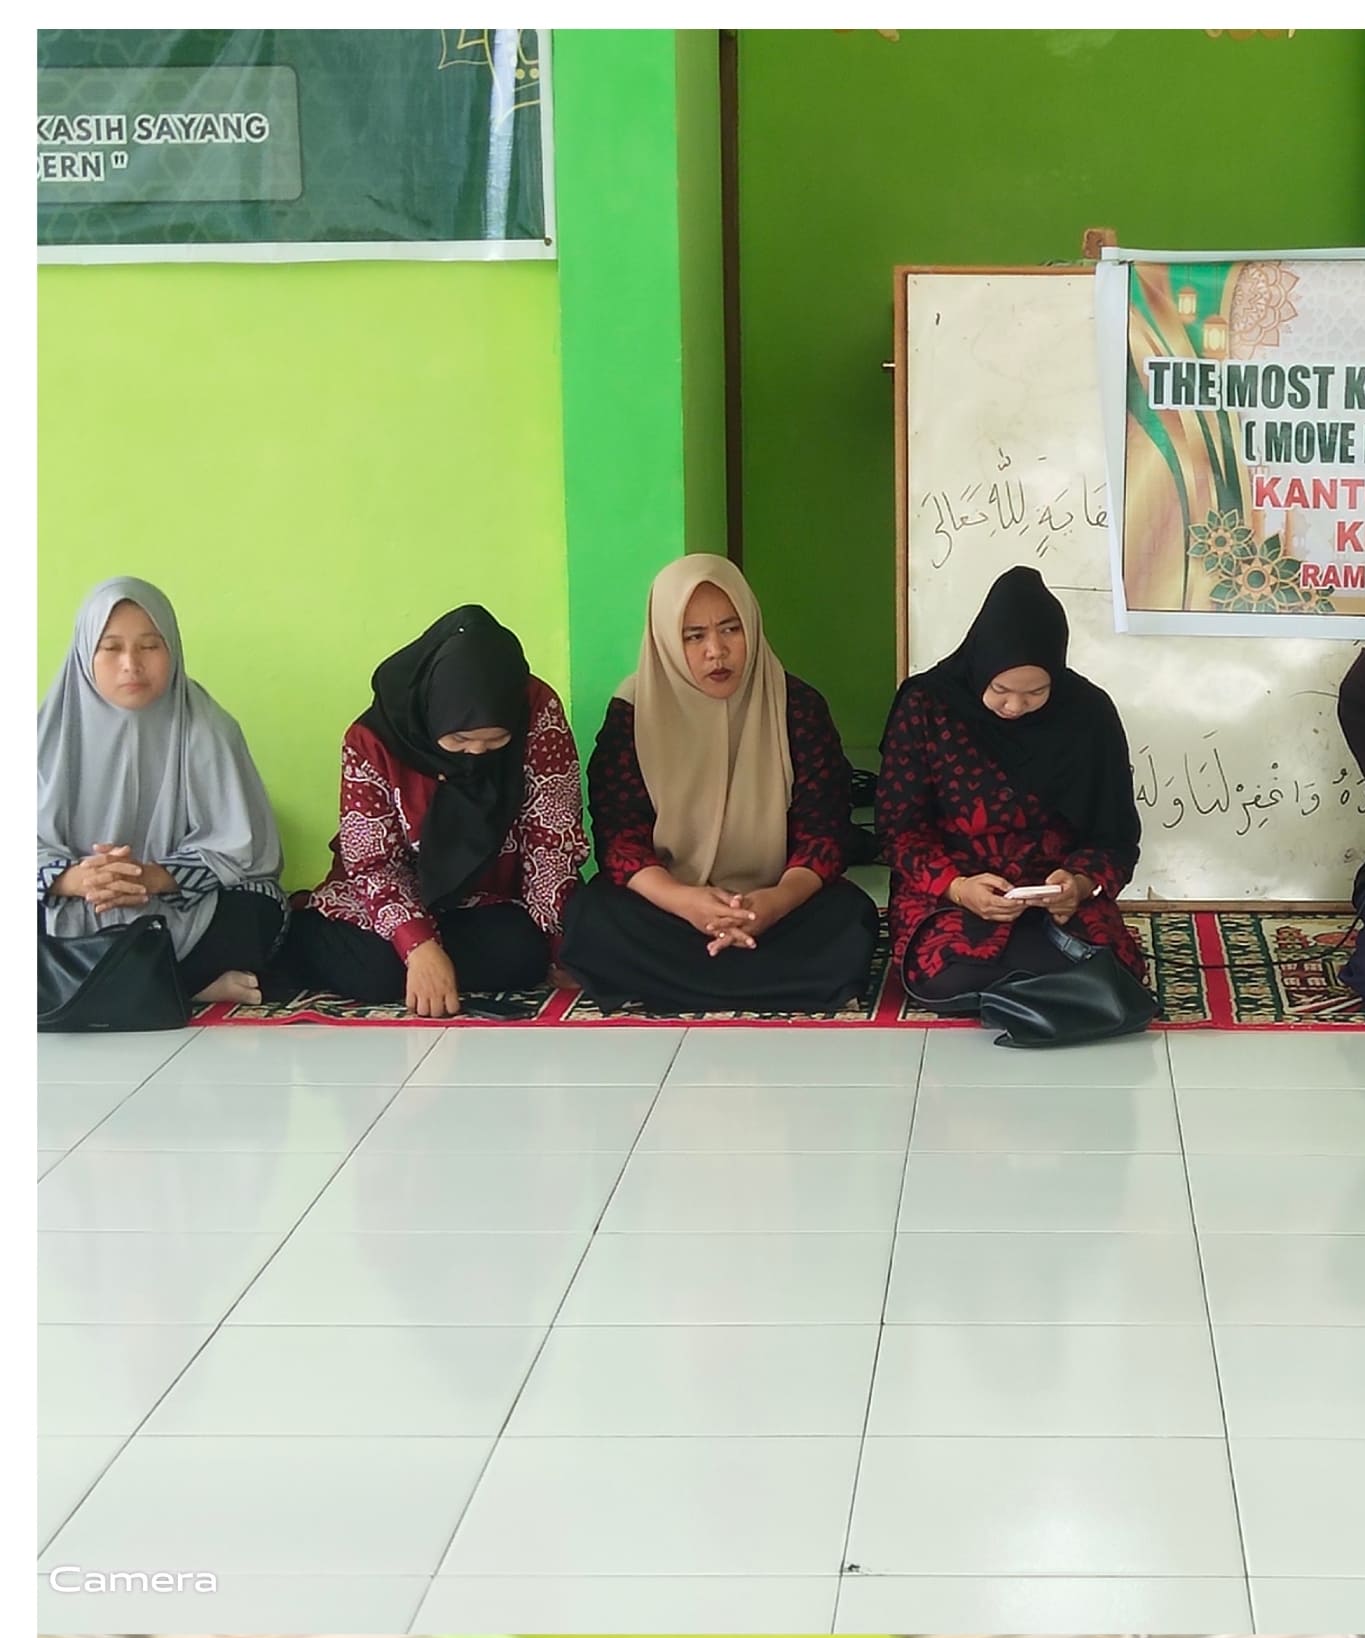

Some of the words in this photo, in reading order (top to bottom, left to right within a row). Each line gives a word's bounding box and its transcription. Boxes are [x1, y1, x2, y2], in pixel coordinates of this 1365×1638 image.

[37, 117, 124, 141] KASIH
[136, 115, 268, 141] SAYANG
[38, 154, 101, 178] ERN
[1148, 361, 1217, 407] THE
[1227, 364, 1336, 410] MOST
[1264, 421, 1356, 464] MOVE
